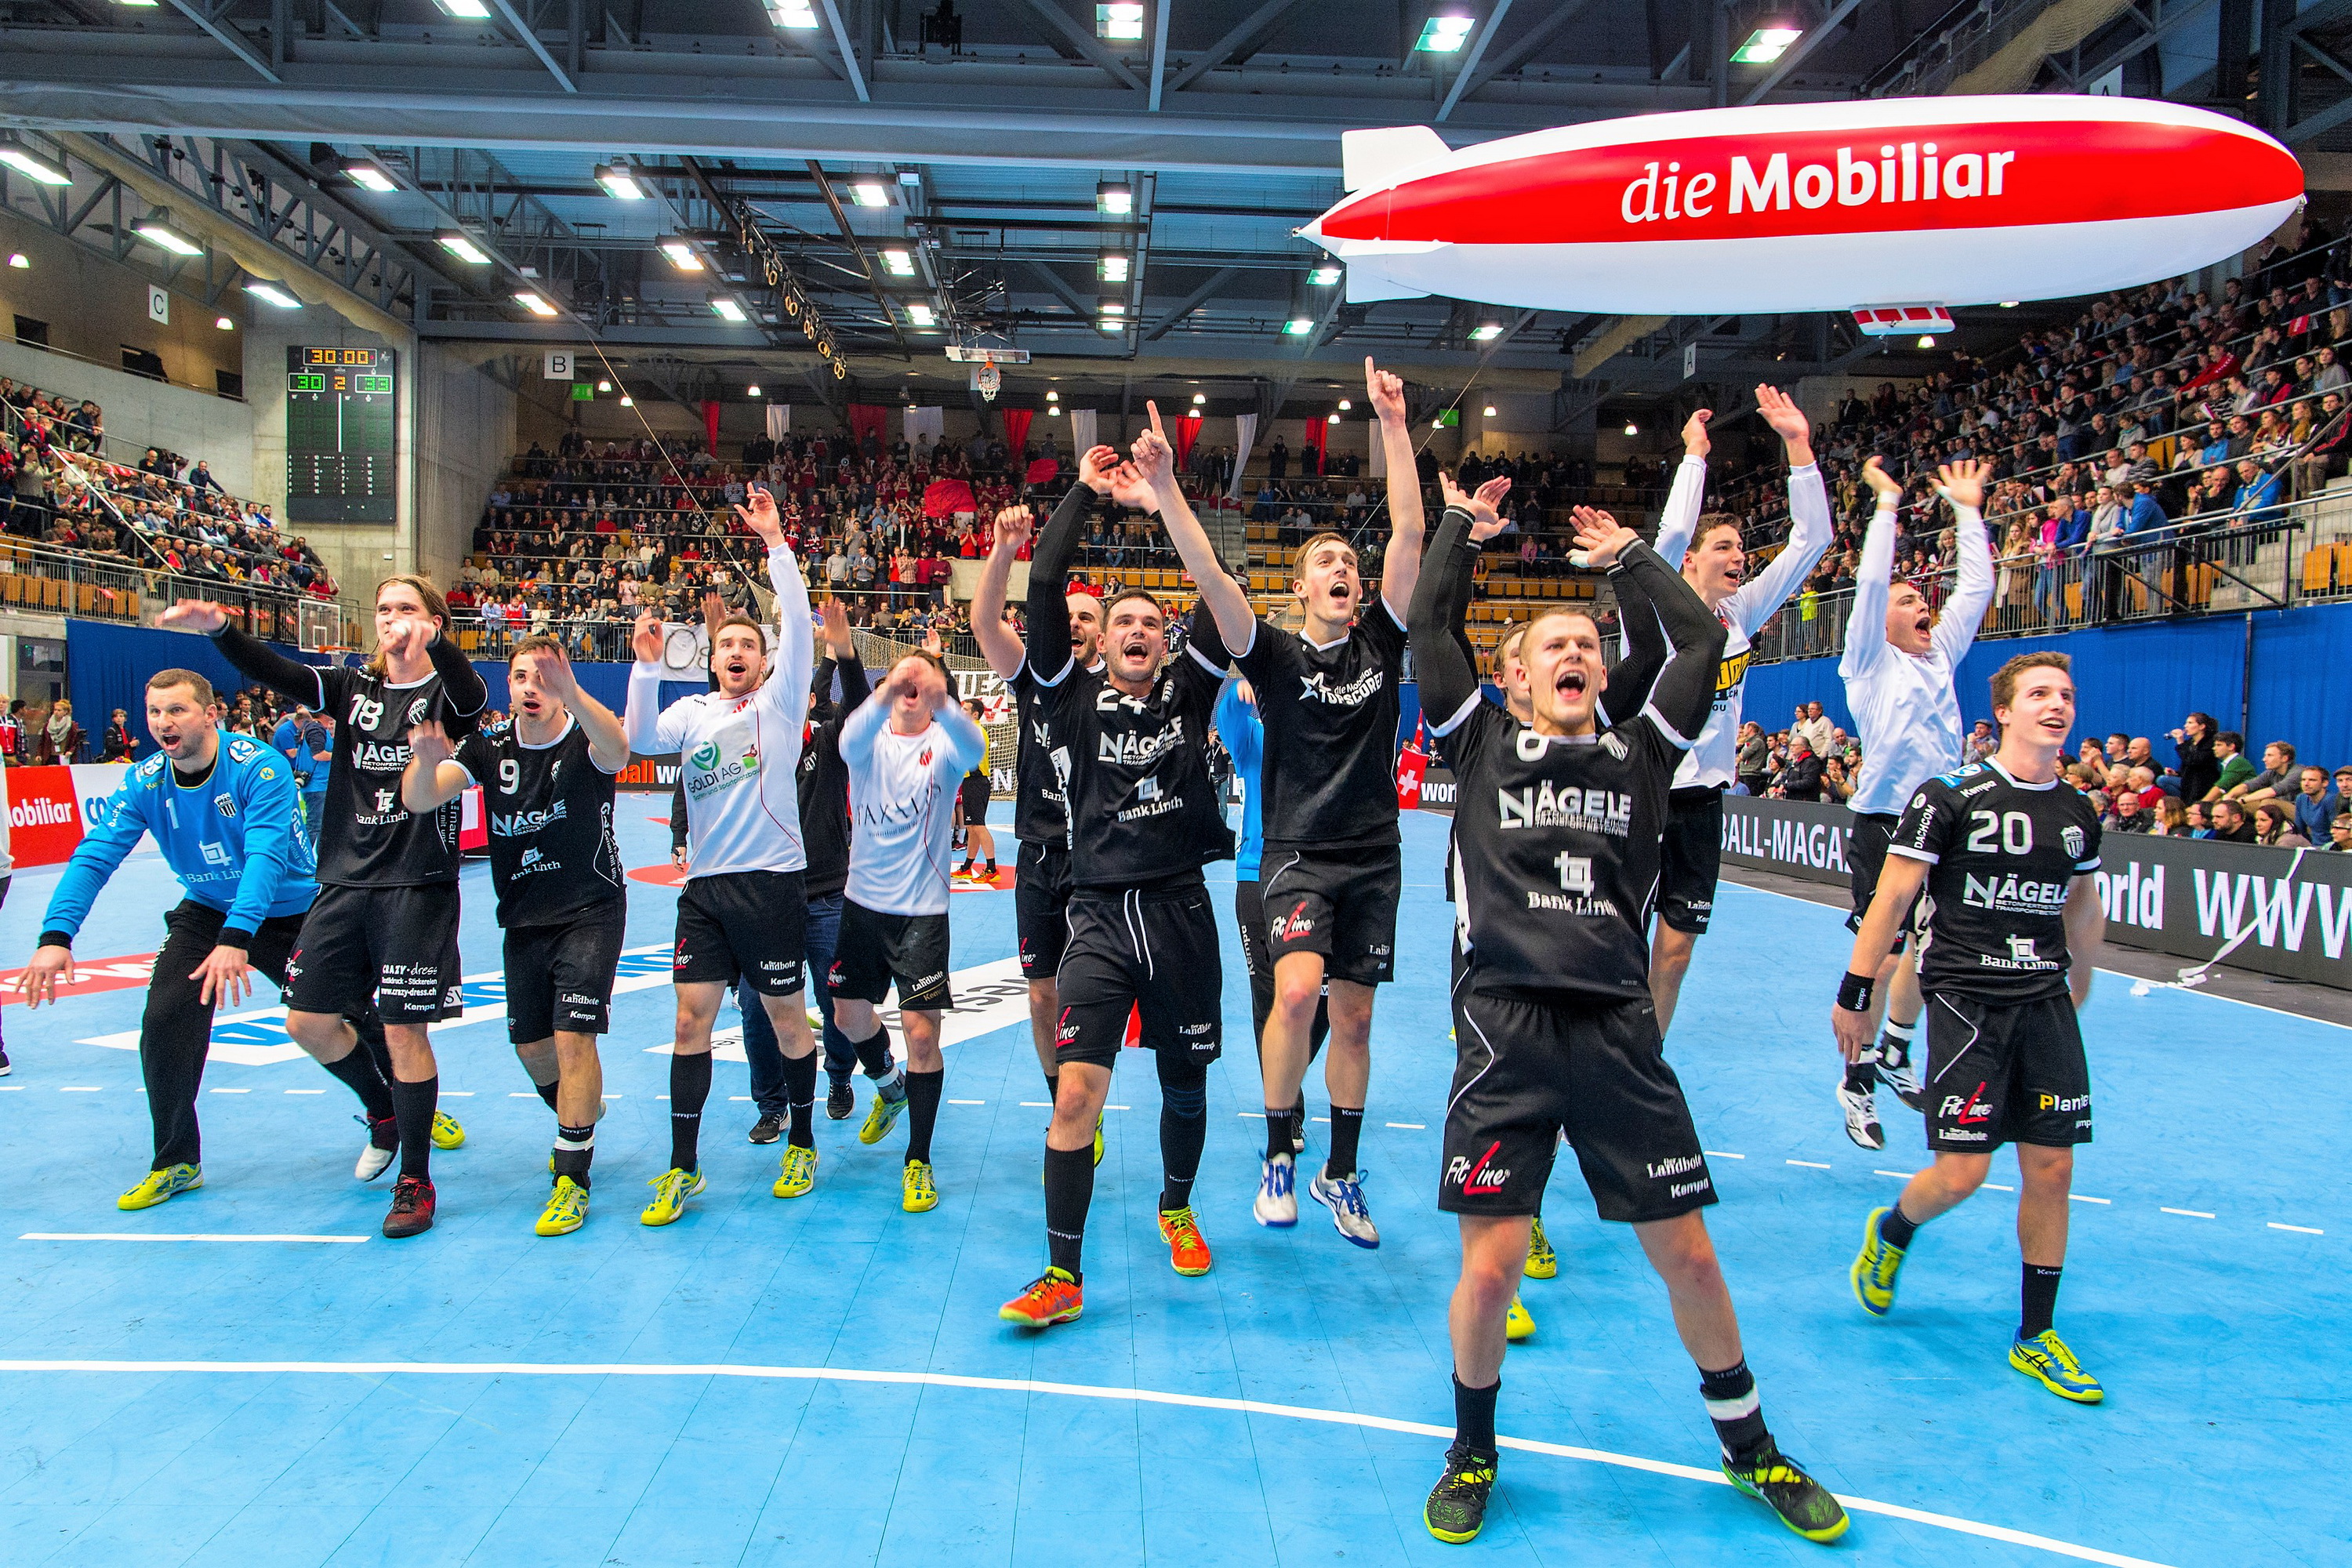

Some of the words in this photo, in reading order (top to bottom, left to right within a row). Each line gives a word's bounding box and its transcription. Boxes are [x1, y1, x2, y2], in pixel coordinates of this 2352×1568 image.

[1621, 162, 1715, 223] die
[1728, 142, 2015, 215] Mobiliar
[154, 294, 164, 314] C
[311, 349, 368, 365] 30:00
[552, 355, 567, 373] B
[1686, 351, 1693, 371] A
[298, 376, 322, 390] 30
[334, 376, 346, 390] 2
[364, 376, 389, 391] 33
[348, 693, 384, 731] 18
[499, 759, 520, 794] 9
[688, 771, 720, 793] GÖLDI
[721, 762, 742, 780] AG
[1960, 780, 1997, 799] Kempa
[165, 797, 179, 830] 1
[1117, 804, 1150, 822] Bank
[1152, 796, 1184, 816] Linth
[1498, 779, 1632, 829] NÄGELE
[1914, 804, 1937, 849] DACHCOM
[1967, 810, 2033, 855] 20
[221, 869, 245, 880] Lin
[1527, 891, 1573, 913] Bank
[411, 961, 437, 975] dress
[760, 960, 796, 971] Landbote
[1980, 953, 2021, 970] Bank
[771, 975, 796, 985] Kempa
[404, 1003, 436, 1012] Kempa
[561, 993, 600, 1006] Landbote
[1854, 987, 1867, 1010] Kempa
[569, 1010, 596, 1022] Kempa
[1444, 1141, 1507, 1196] FitLine
[1646, 1152, 1702, 1179] Landbote
[1670, 1178, 1709, 1199] Kempa
